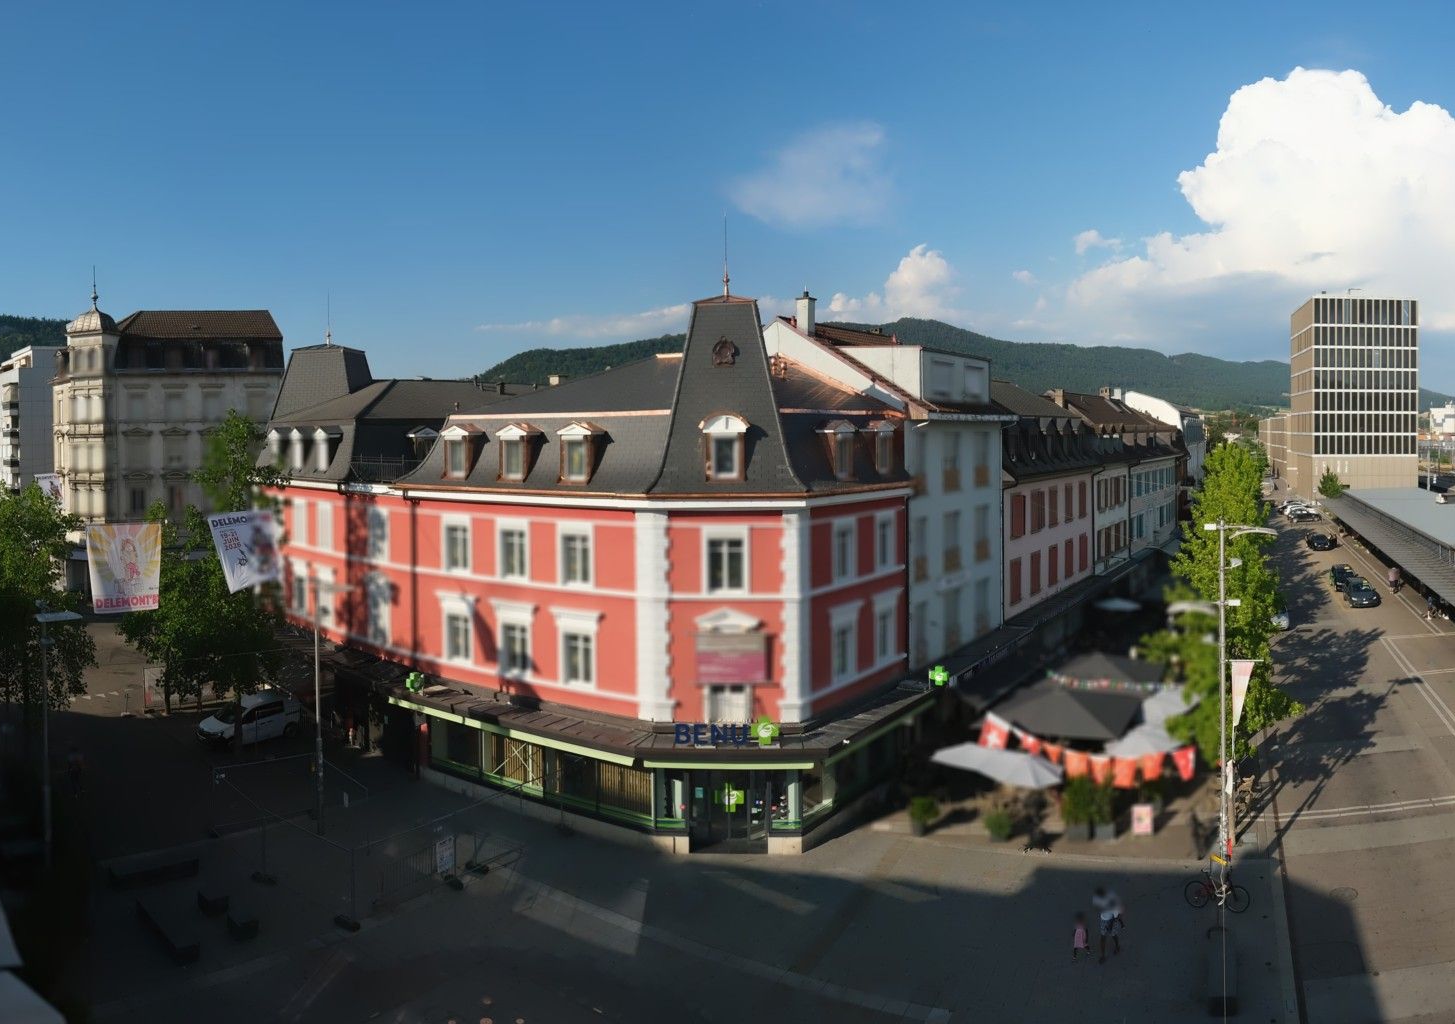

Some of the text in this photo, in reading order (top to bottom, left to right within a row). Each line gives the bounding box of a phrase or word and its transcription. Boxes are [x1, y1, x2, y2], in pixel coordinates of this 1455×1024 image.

[211, 516, 251, 528] DELEMO
[223, 536, 240, 545] JUIN
[225, 542, 242, 551] 2026
[674, 723, 749, 746] BENU
